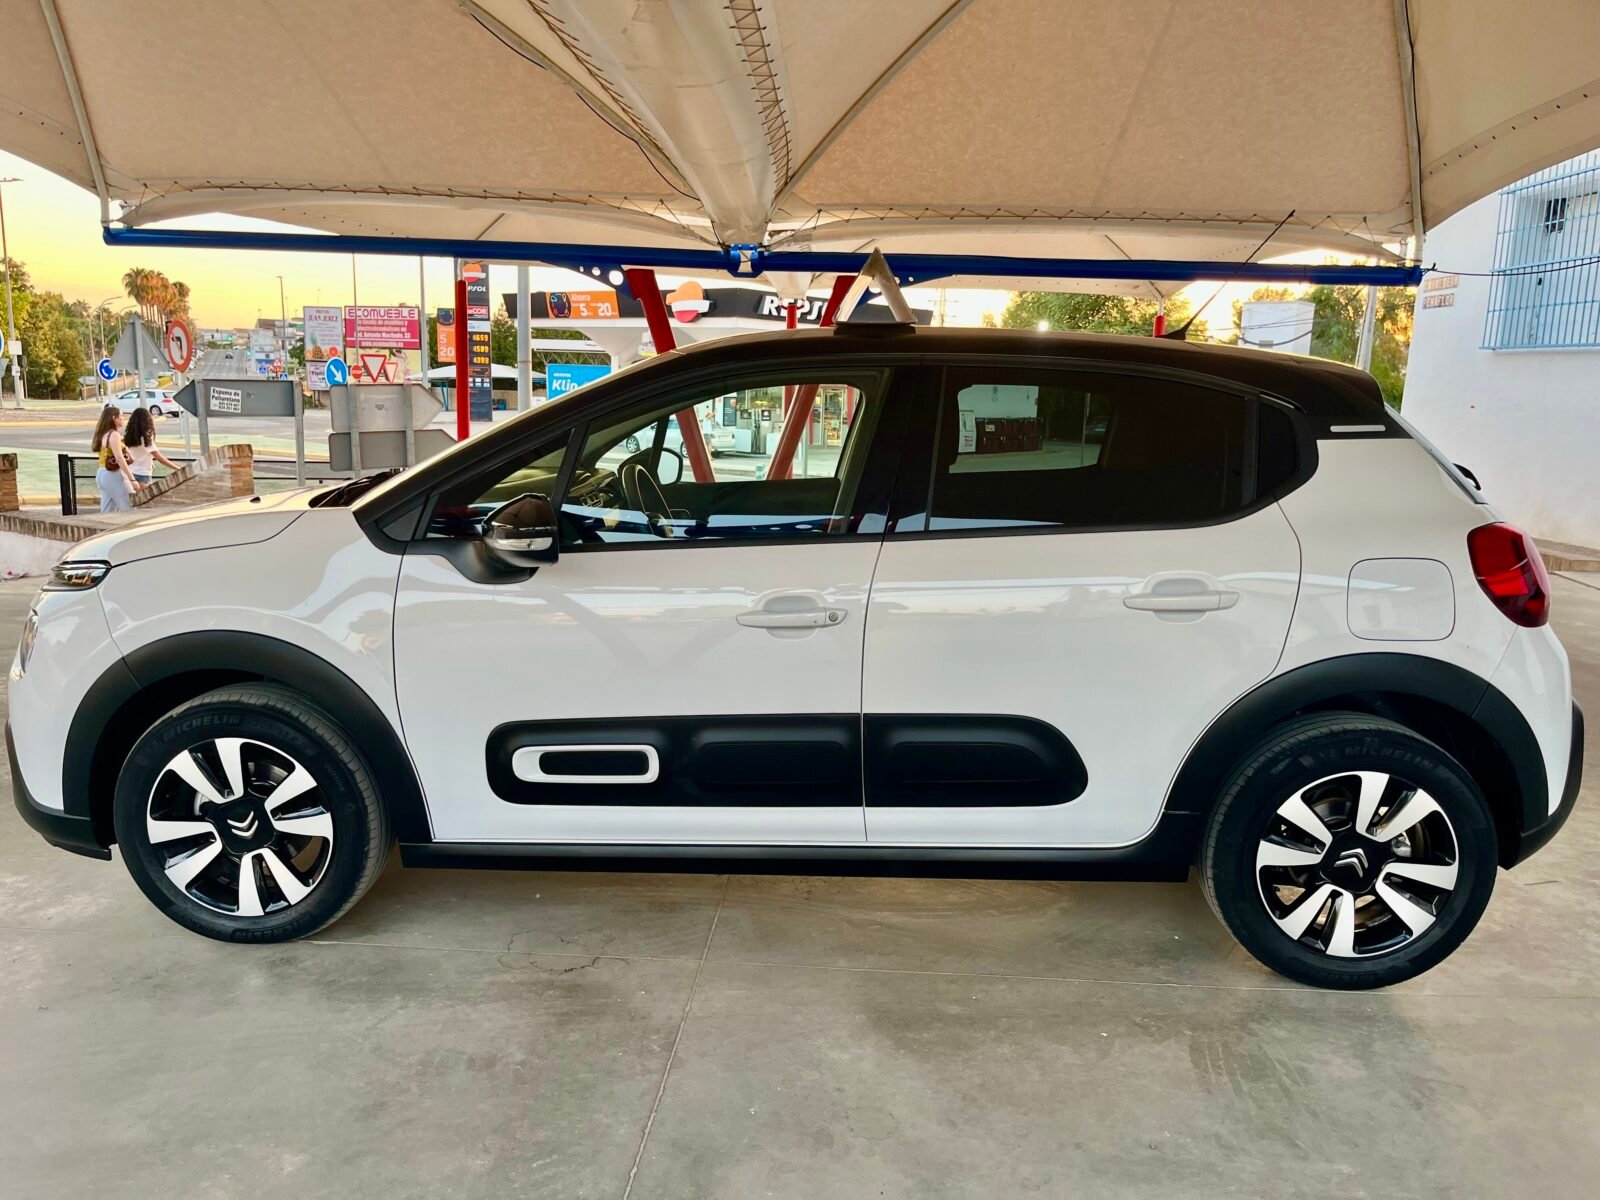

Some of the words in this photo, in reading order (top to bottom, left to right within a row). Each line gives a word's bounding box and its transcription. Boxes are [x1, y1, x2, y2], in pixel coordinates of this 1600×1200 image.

[579, 302, 588, 317] 5
[597, 302, 612, 317] 20
[440, 347, 455, 357] 20
[163, 714, 241, 741] MICHELIN
[1345, 745, 1434, 769] MICHELIN
